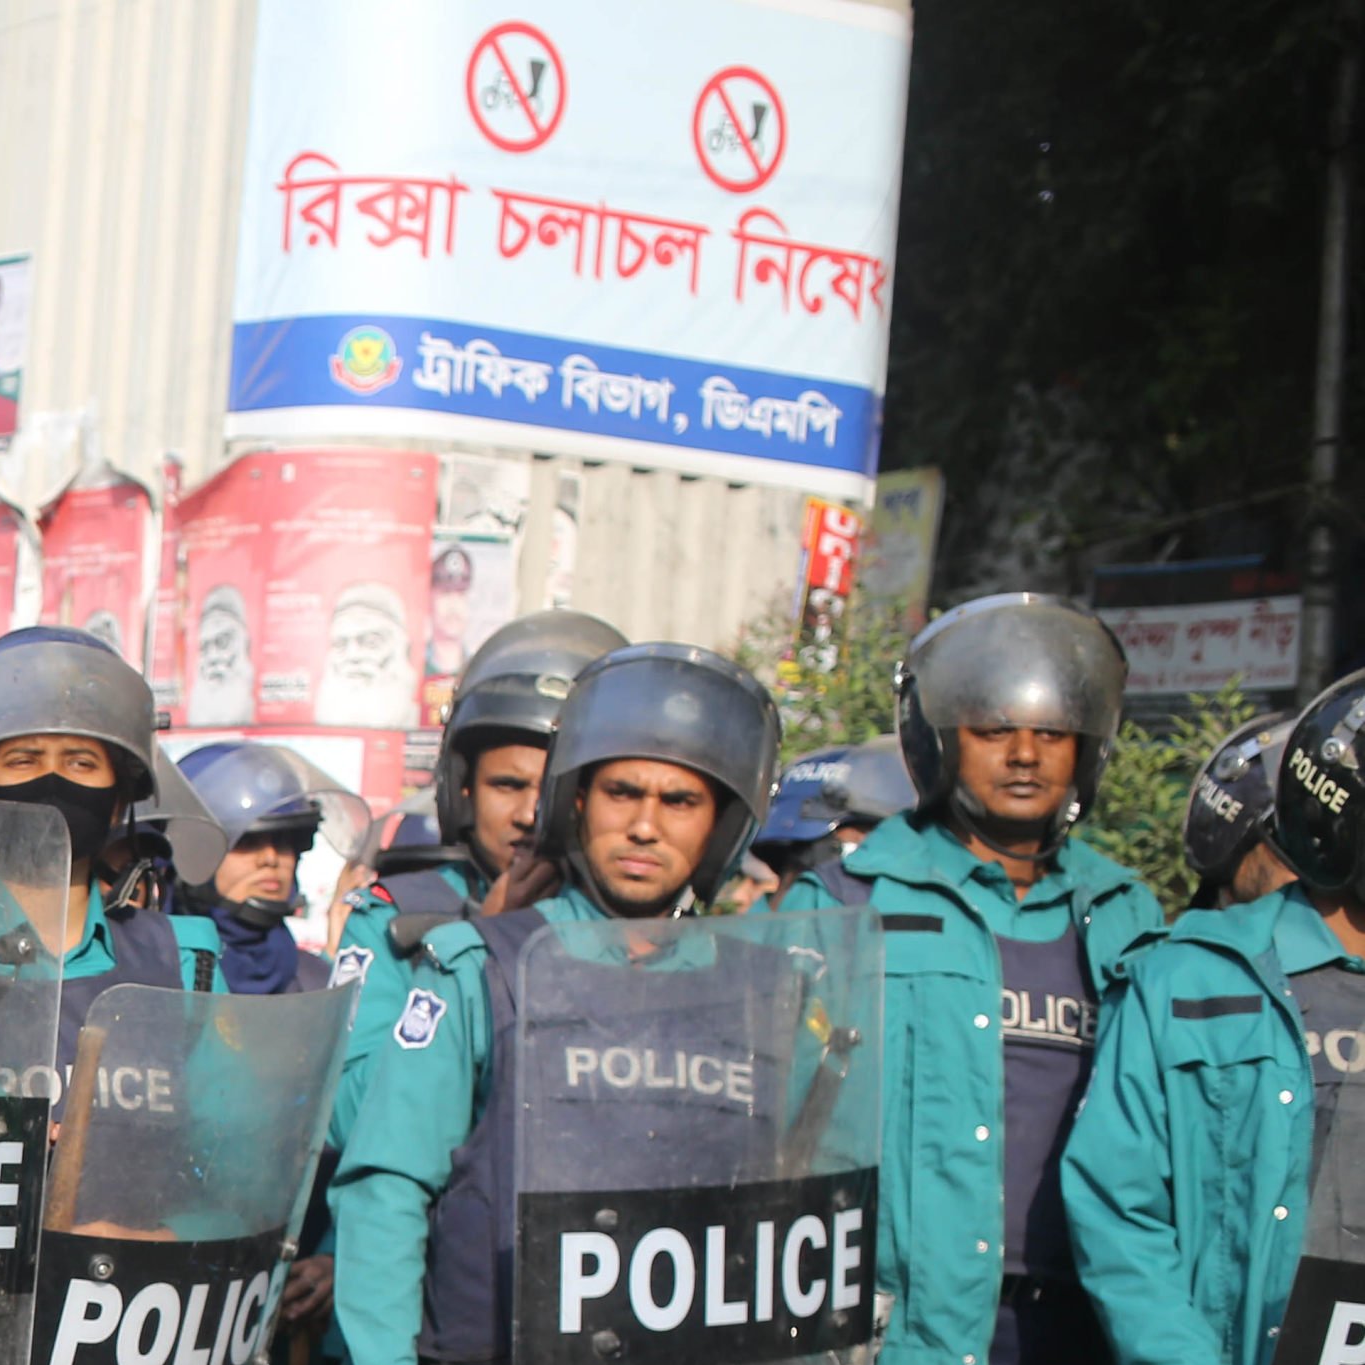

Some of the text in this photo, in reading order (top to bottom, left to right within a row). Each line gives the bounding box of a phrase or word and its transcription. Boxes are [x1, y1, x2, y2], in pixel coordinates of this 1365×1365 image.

[277, 150, 470, 259] রিক্সা
[490, 186, 712, 298] চলাচল
[412, 332, 843, 448] ট্রাফিক বিভাগ, ডিএমপি
[1288, 747, 1351, 815] POLICE
[566, 1046, 755, 1103] POLICE
[559, 1207, 864, 1334] POLICE
